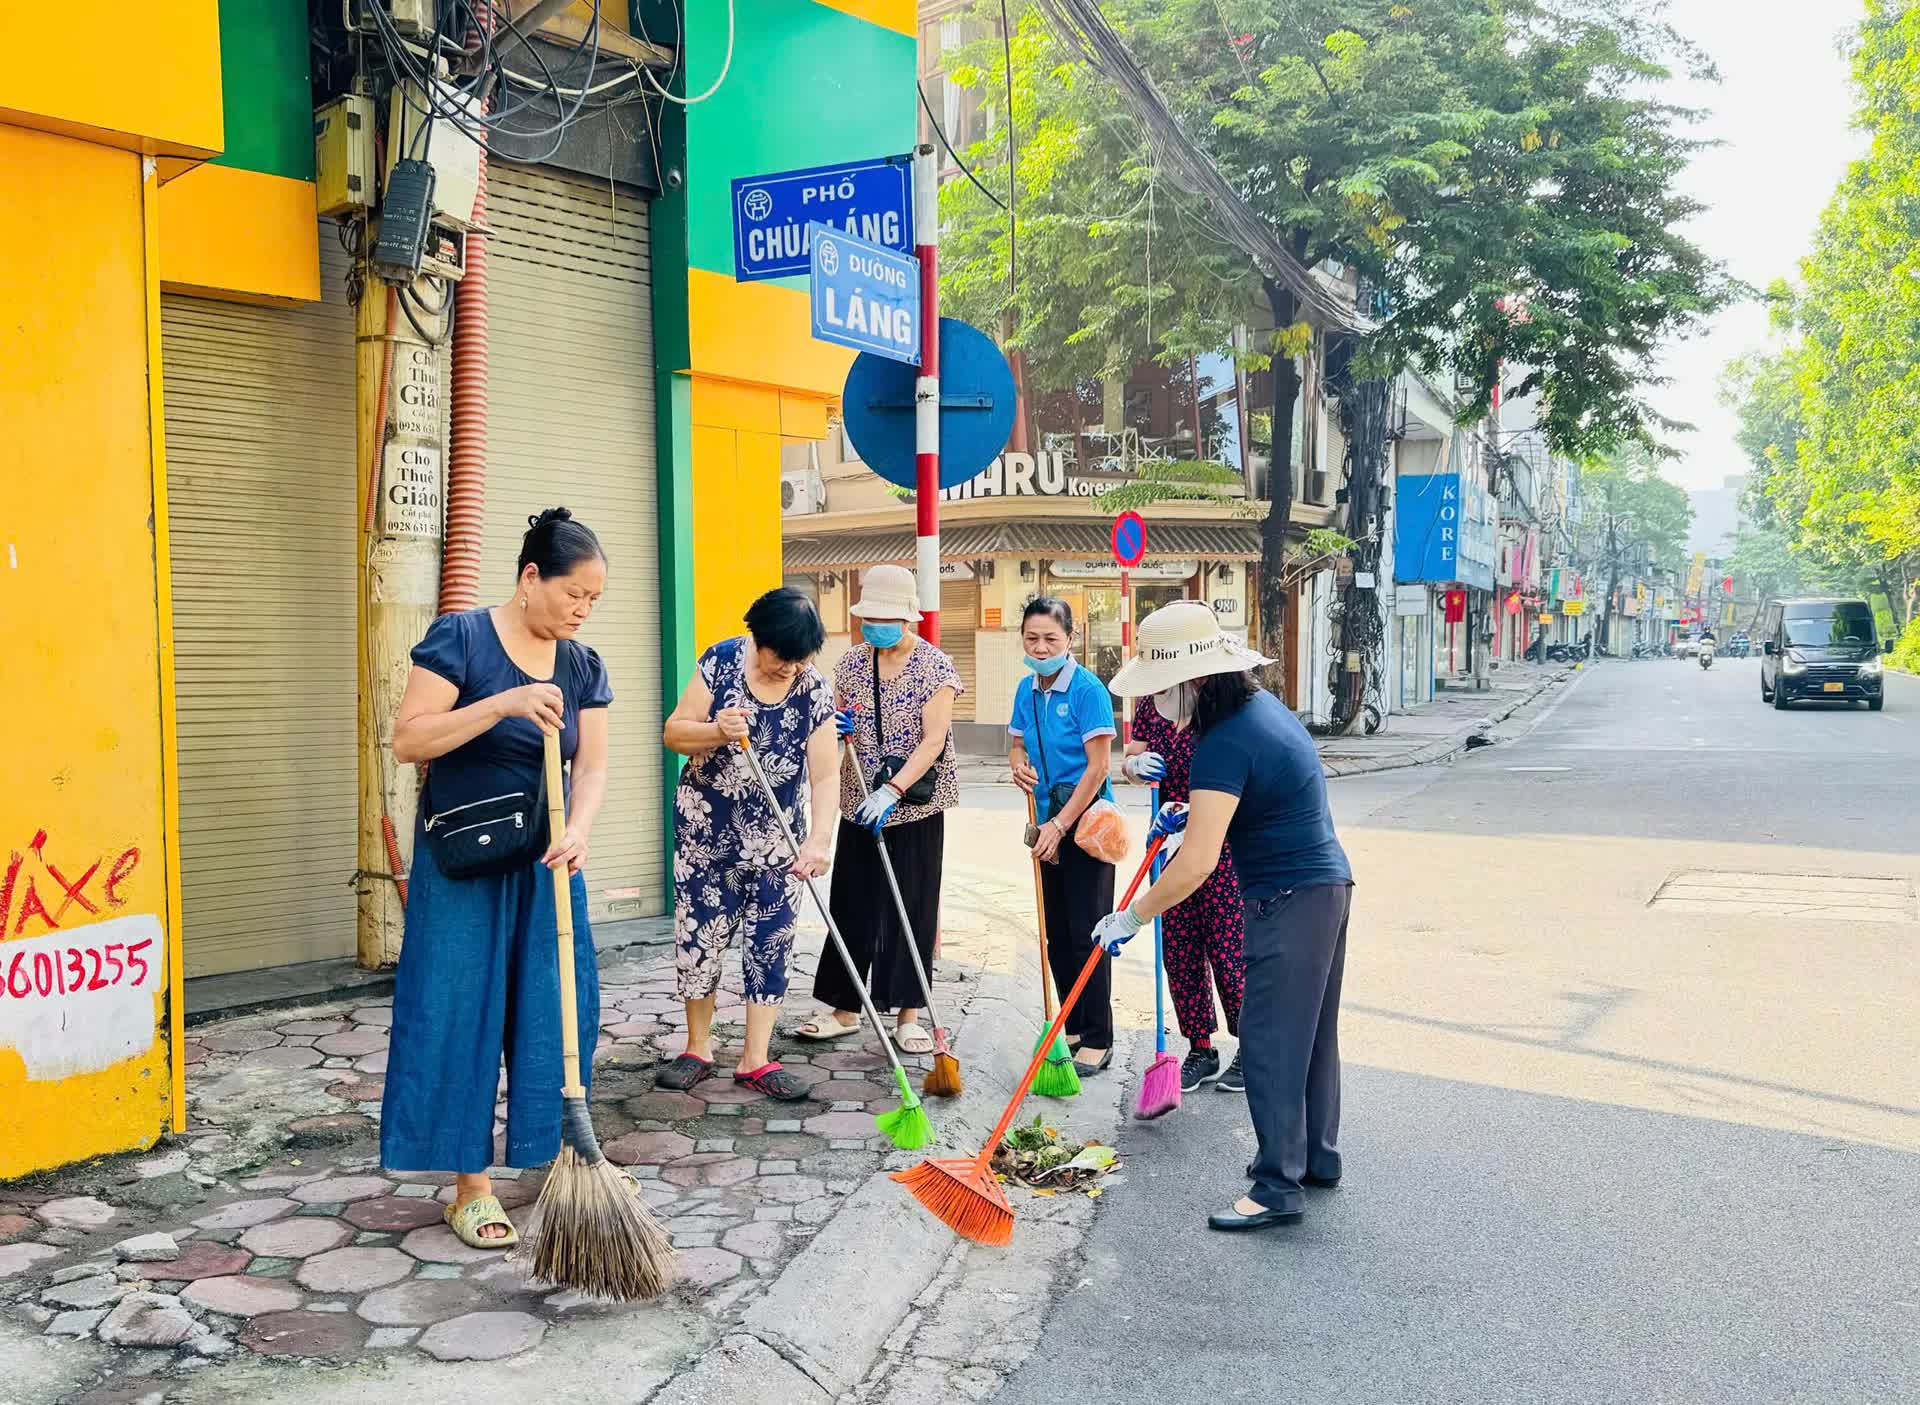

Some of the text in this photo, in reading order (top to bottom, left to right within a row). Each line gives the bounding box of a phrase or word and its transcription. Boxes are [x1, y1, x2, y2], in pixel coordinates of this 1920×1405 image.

[802, 173, 855, 205] PHỐ
[827, 207, 900, 246] ÁNG
[826, 287, 912, 345] LÁNG
[401, 450, 430, 466] Cho
[397, 468, 434, 484] Thuê
[389, 484, 438, 508] Giáo
[387, 521, 411, 532] 0928
[1440, 484, 1456, 561] KORE
[1151, 648, 1179, 660] Dior
[1189, 639, 1214, 655] Dior
[0, 939, 152, 998] 6013255
